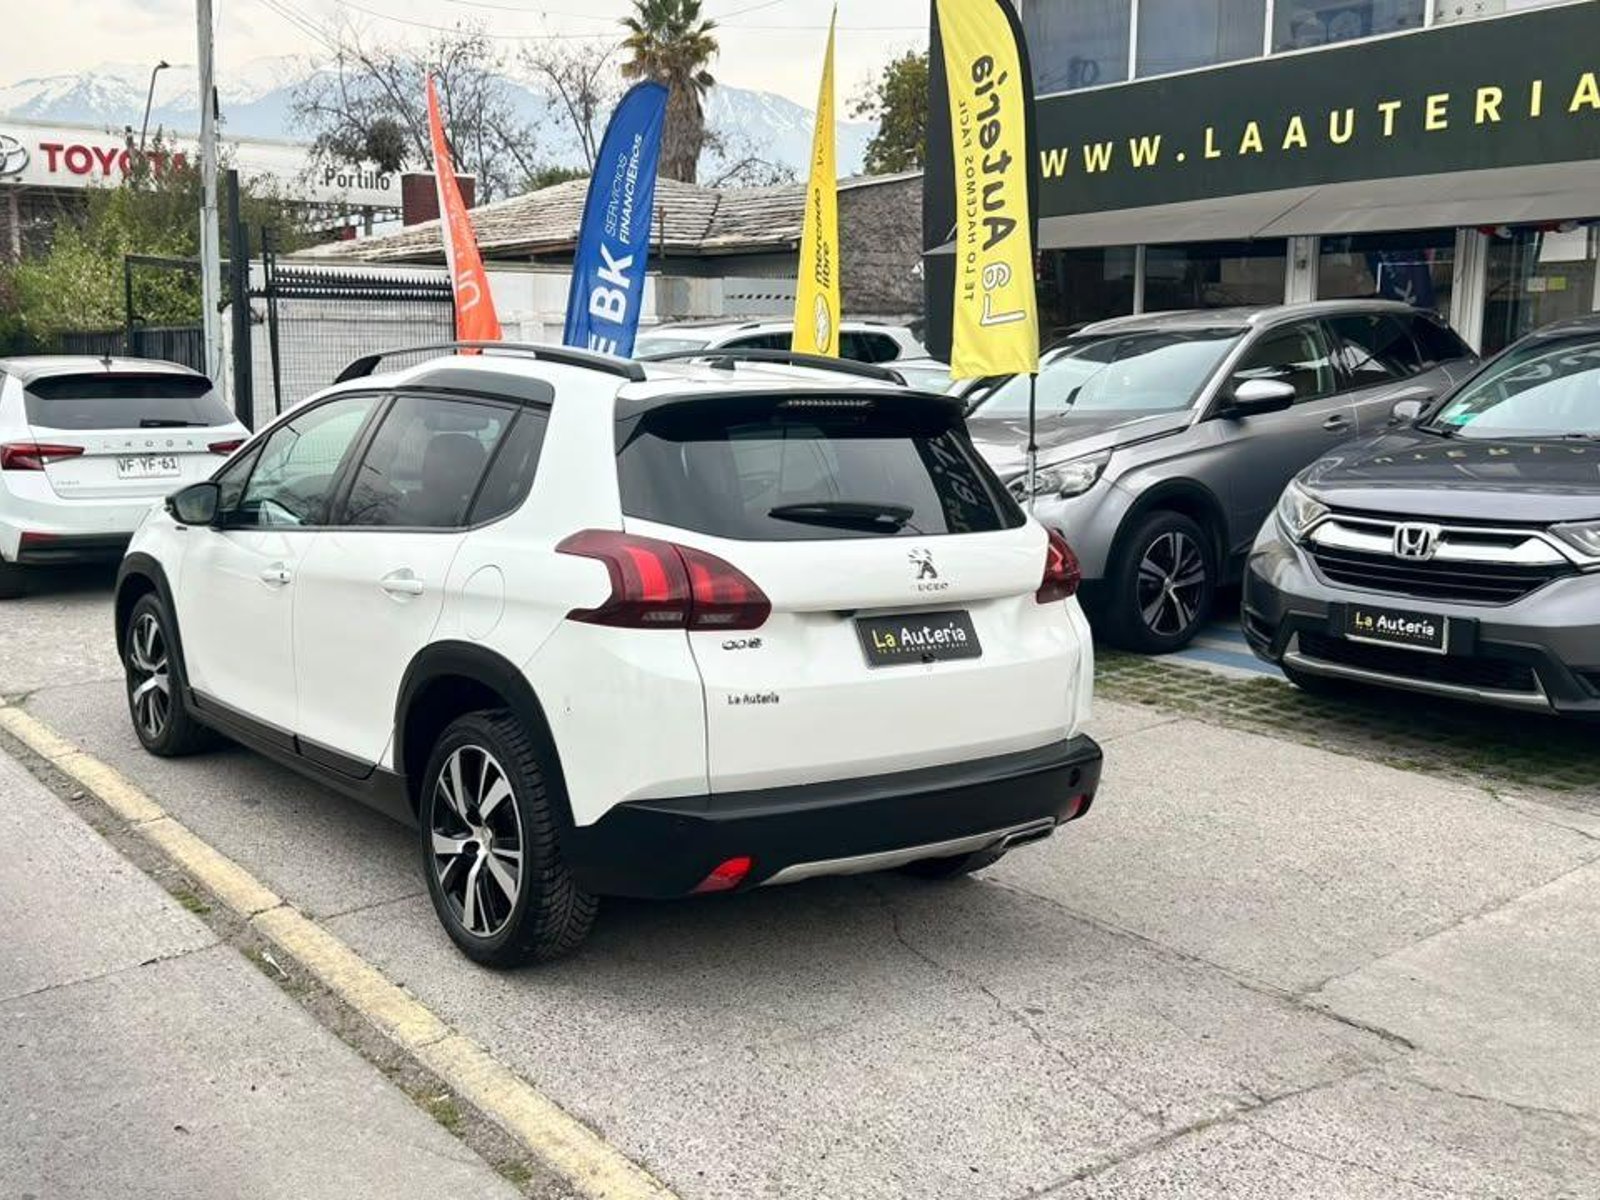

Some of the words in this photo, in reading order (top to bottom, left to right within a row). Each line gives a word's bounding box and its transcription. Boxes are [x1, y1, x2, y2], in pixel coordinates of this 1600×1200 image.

[325, 167, 391, 191] Portillo
[618, 132, 644, 246] FINANCIEROS
[604, 152, 629, 239] SERVICIOS
[589, 242, 634, 324] BK
[871, 628, 897, 649] La
[900, 621, 967, 647] Autería
[1355, 611, 1373, 627] La
[1376, 614, 1436, 636] Autería
[727, 694, 741, 706] La
